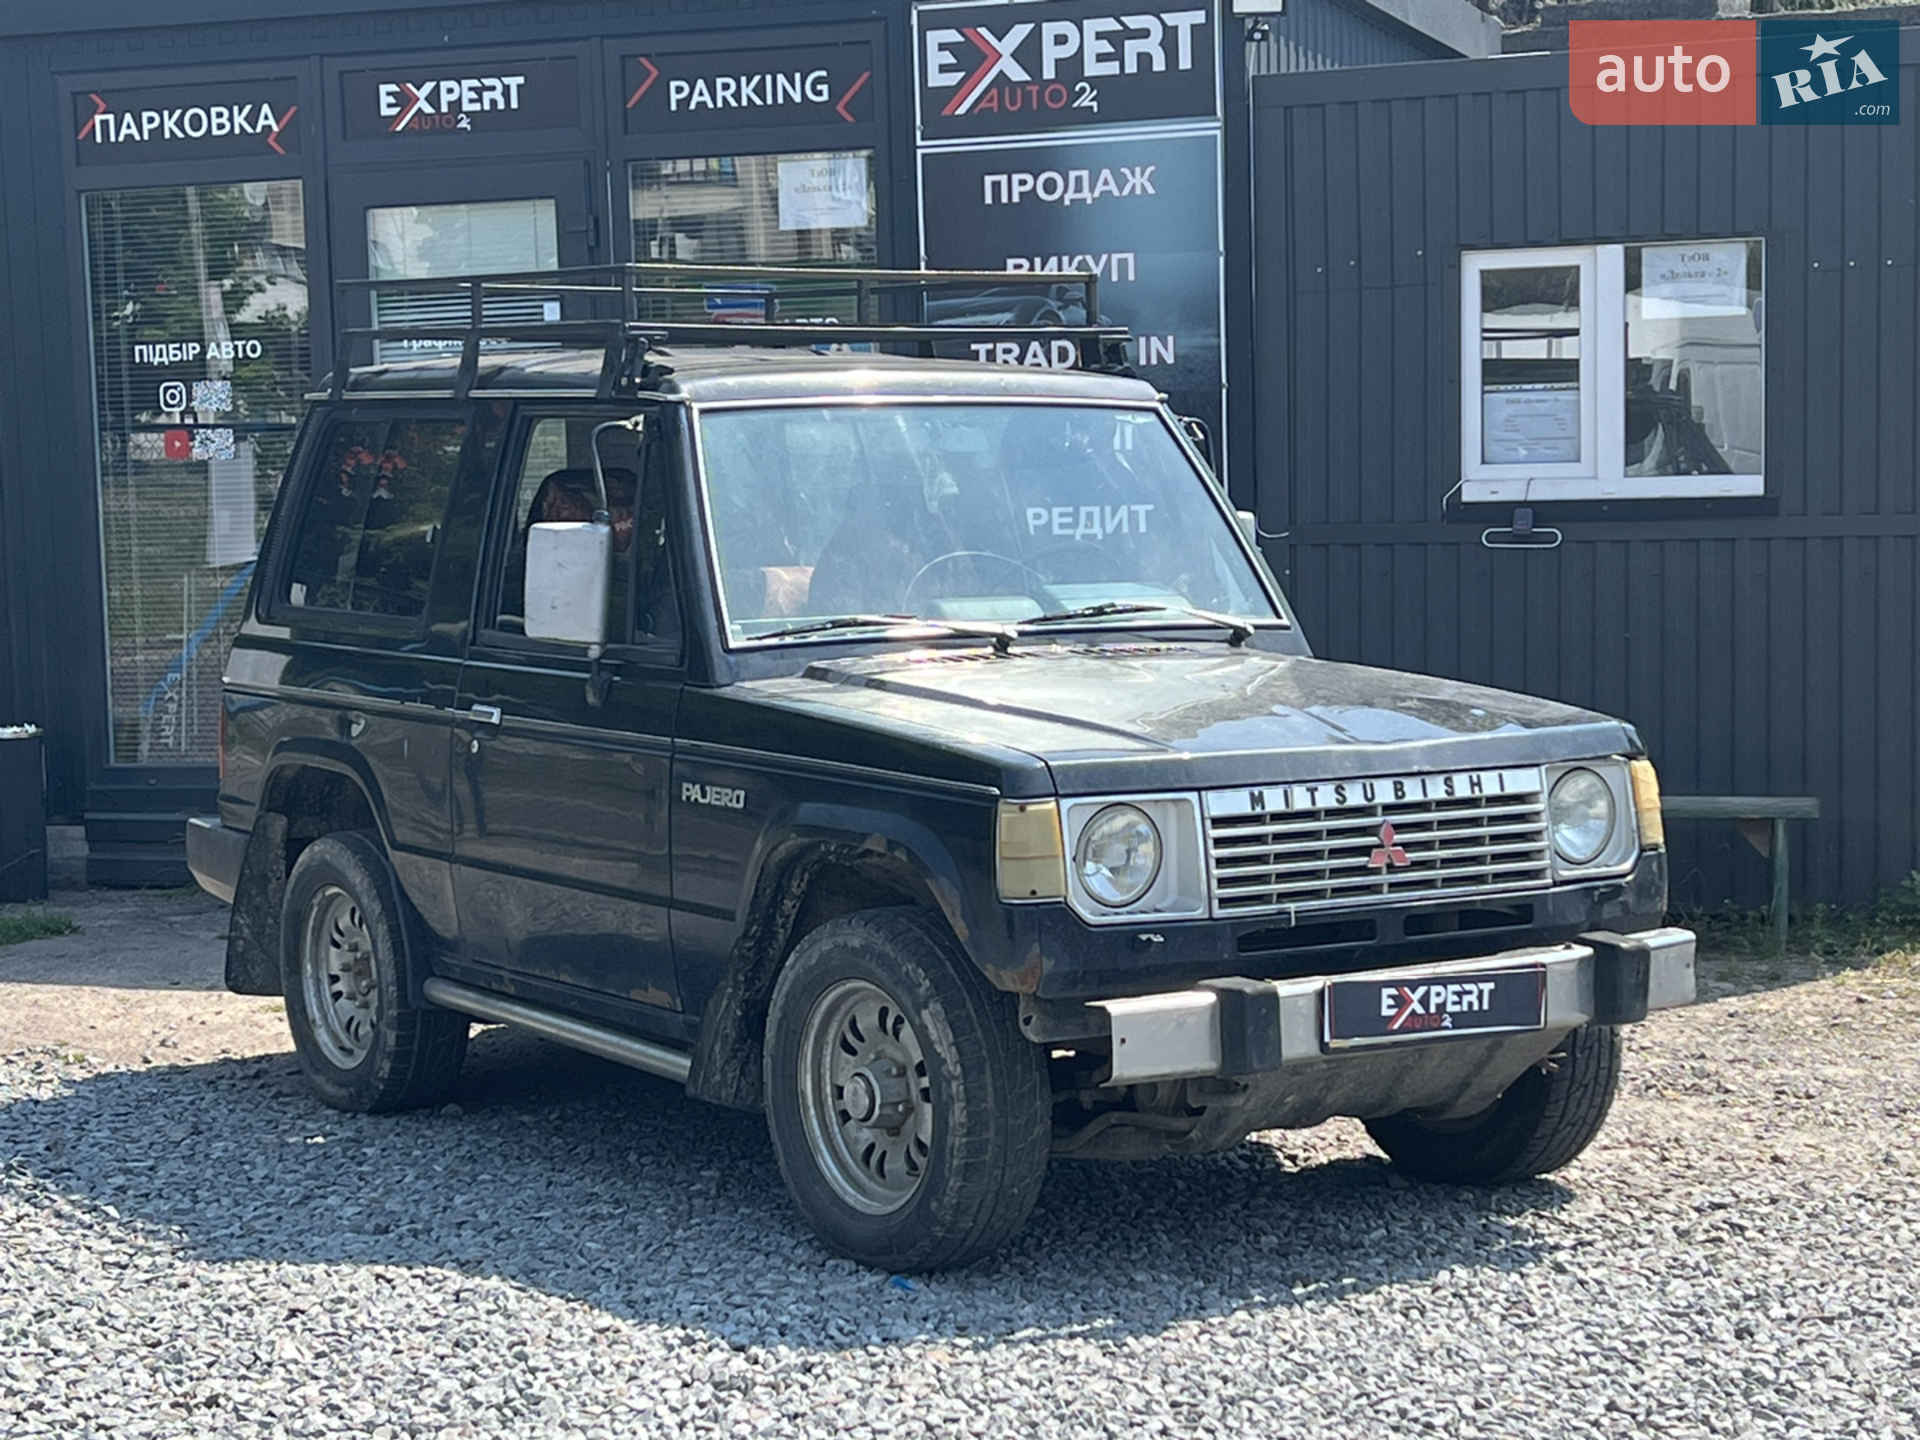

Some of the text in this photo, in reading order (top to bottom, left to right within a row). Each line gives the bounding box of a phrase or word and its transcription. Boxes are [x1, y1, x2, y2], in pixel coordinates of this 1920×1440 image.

[925, 10, 1207, 116] EXPERT
[378, 76, 525, 132] EXPERT
[668, 70, 830, 112] PARKING
[94, 103, 280, 144] ПАРКОВКА
[983, 165, 1157, 206] ПРОДАЖ
[134, 340, 262, 366] ПІДБІР АВТО
[970, 335, 1175, 369] TRAD IN
[681, 781, 746, 809] PAJERO
[1249, 771, 1506, 812] MITSUBISHI
[1380, 981, 1495, 1030] EXPERT
